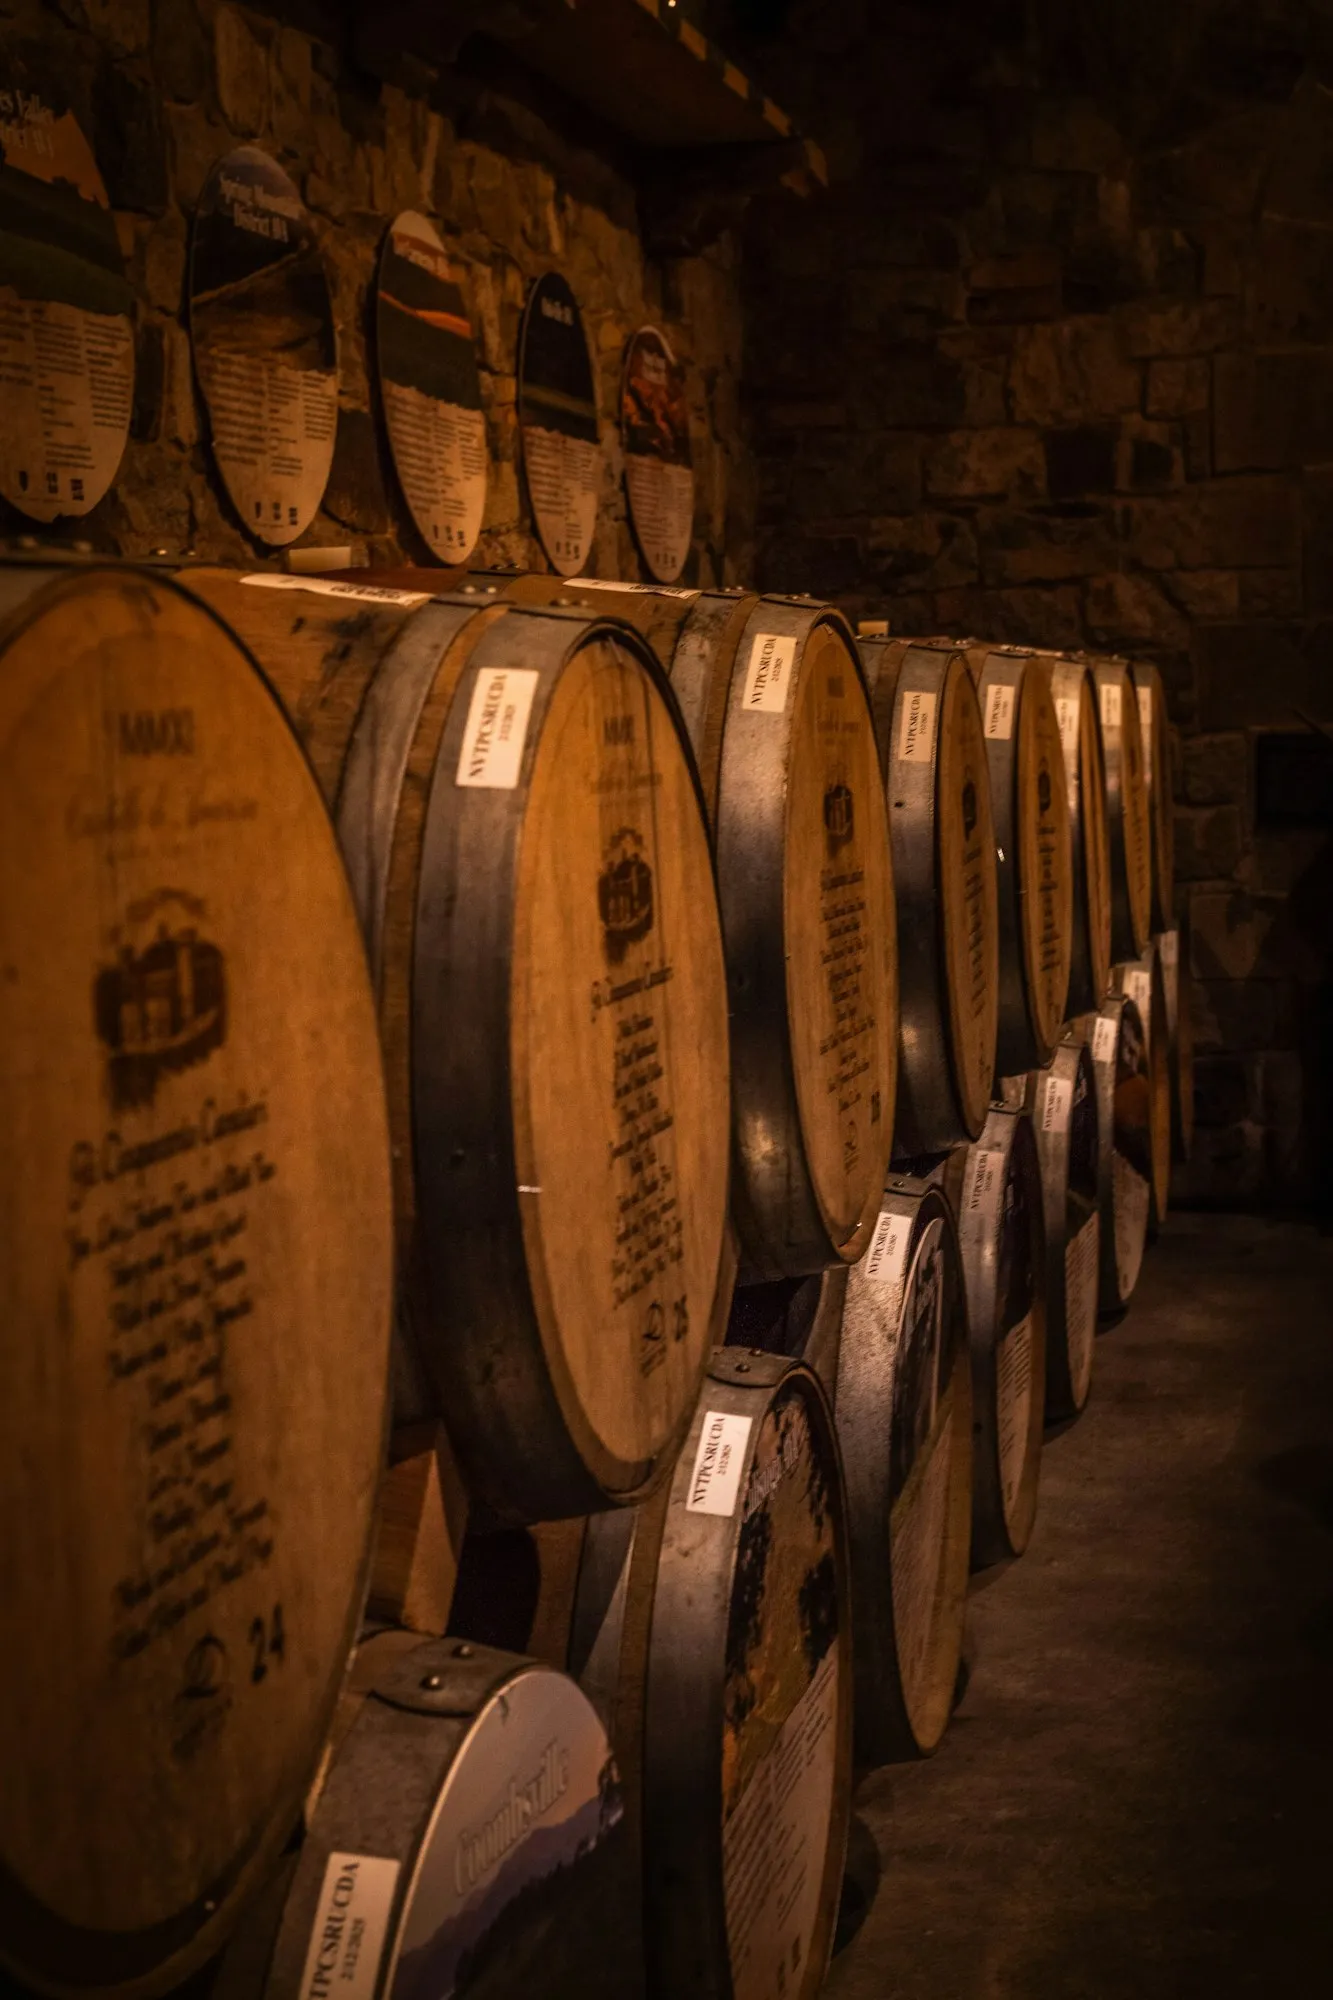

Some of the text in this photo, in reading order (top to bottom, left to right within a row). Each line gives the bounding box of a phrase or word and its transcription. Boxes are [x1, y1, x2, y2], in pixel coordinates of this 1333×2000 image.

[468, 673, 509, 779] NVTPCSRUCDA
[691, 1417, 726, 1505] NVTPCSRUCDA
[249, 1602, 286, 1684] 24
[340, 1916, 367, 1982] 2/12/2025
